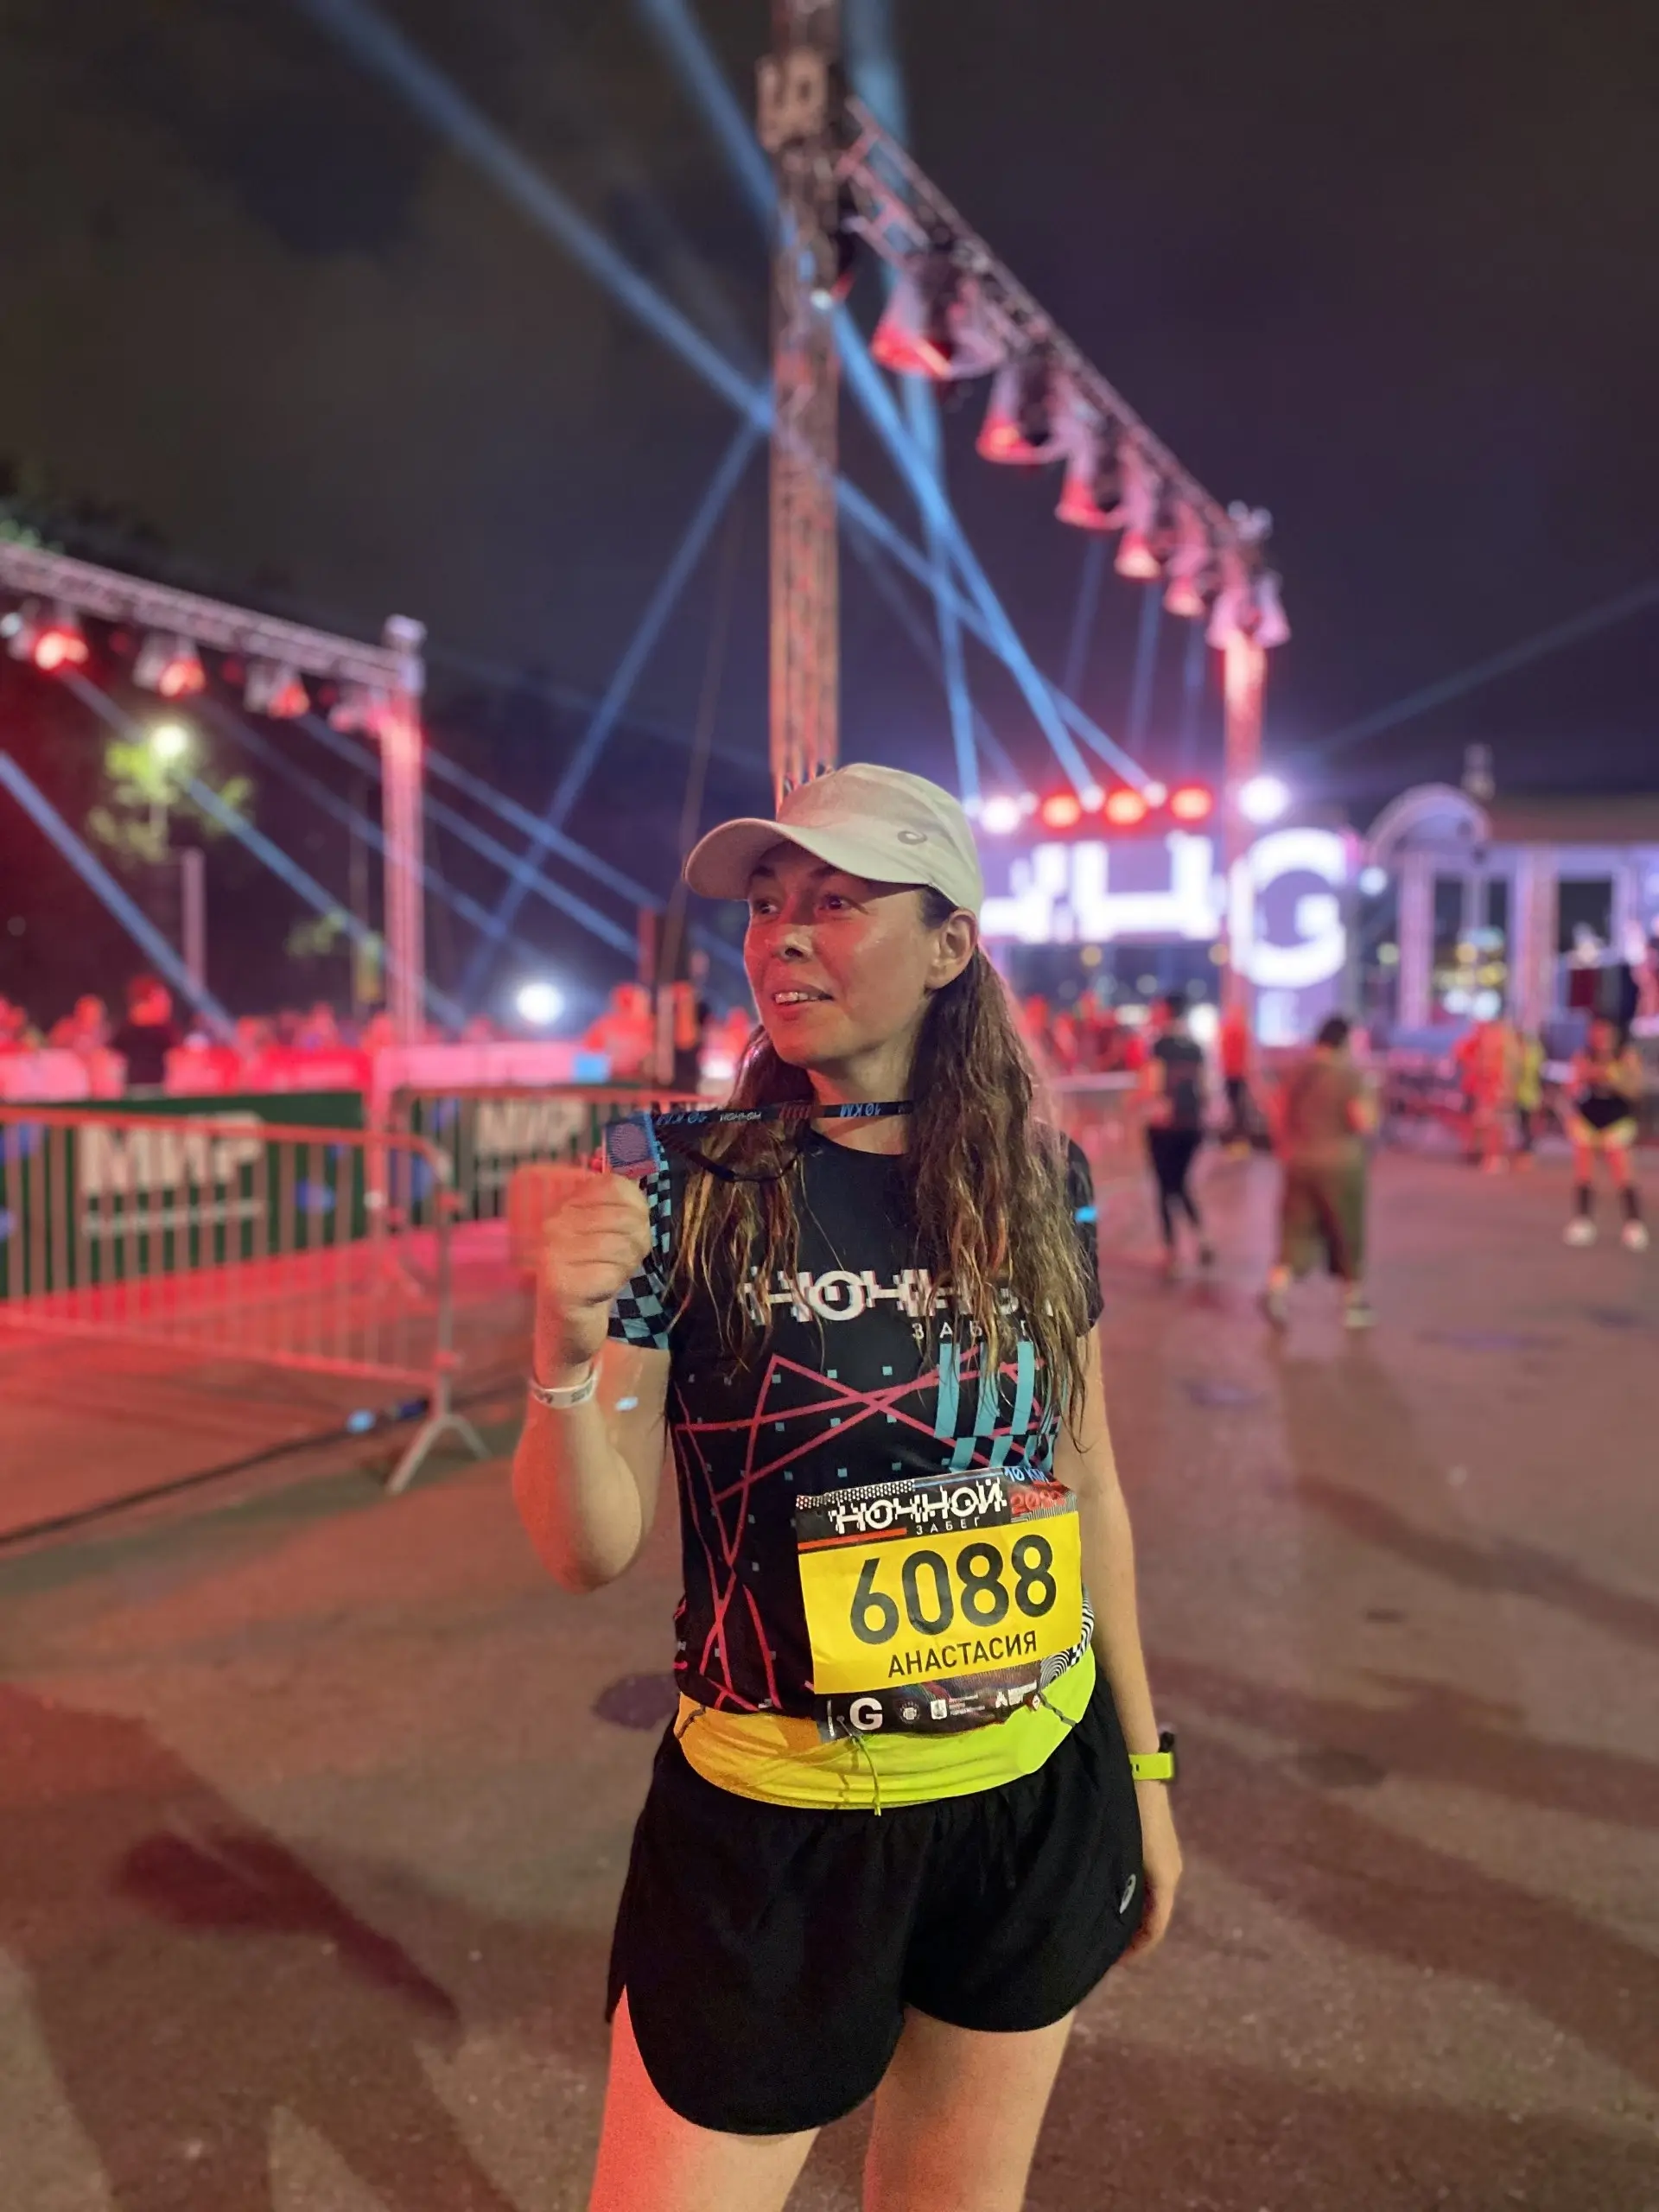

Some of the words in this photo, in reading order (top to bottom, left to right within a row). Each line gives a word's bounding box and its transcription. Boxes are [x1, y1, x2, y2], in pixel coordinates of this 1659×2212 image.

[828, 1477, 1007, 1535] НОЧНОЙ
[916, 1516, 980, 1535] ЗАБЕГ
[849, 1534, 1058, 1645] 6088
[887, 1630, 1037, 1678] АНАСТАСИЯ
[849, 1697, 883, 1731] G
